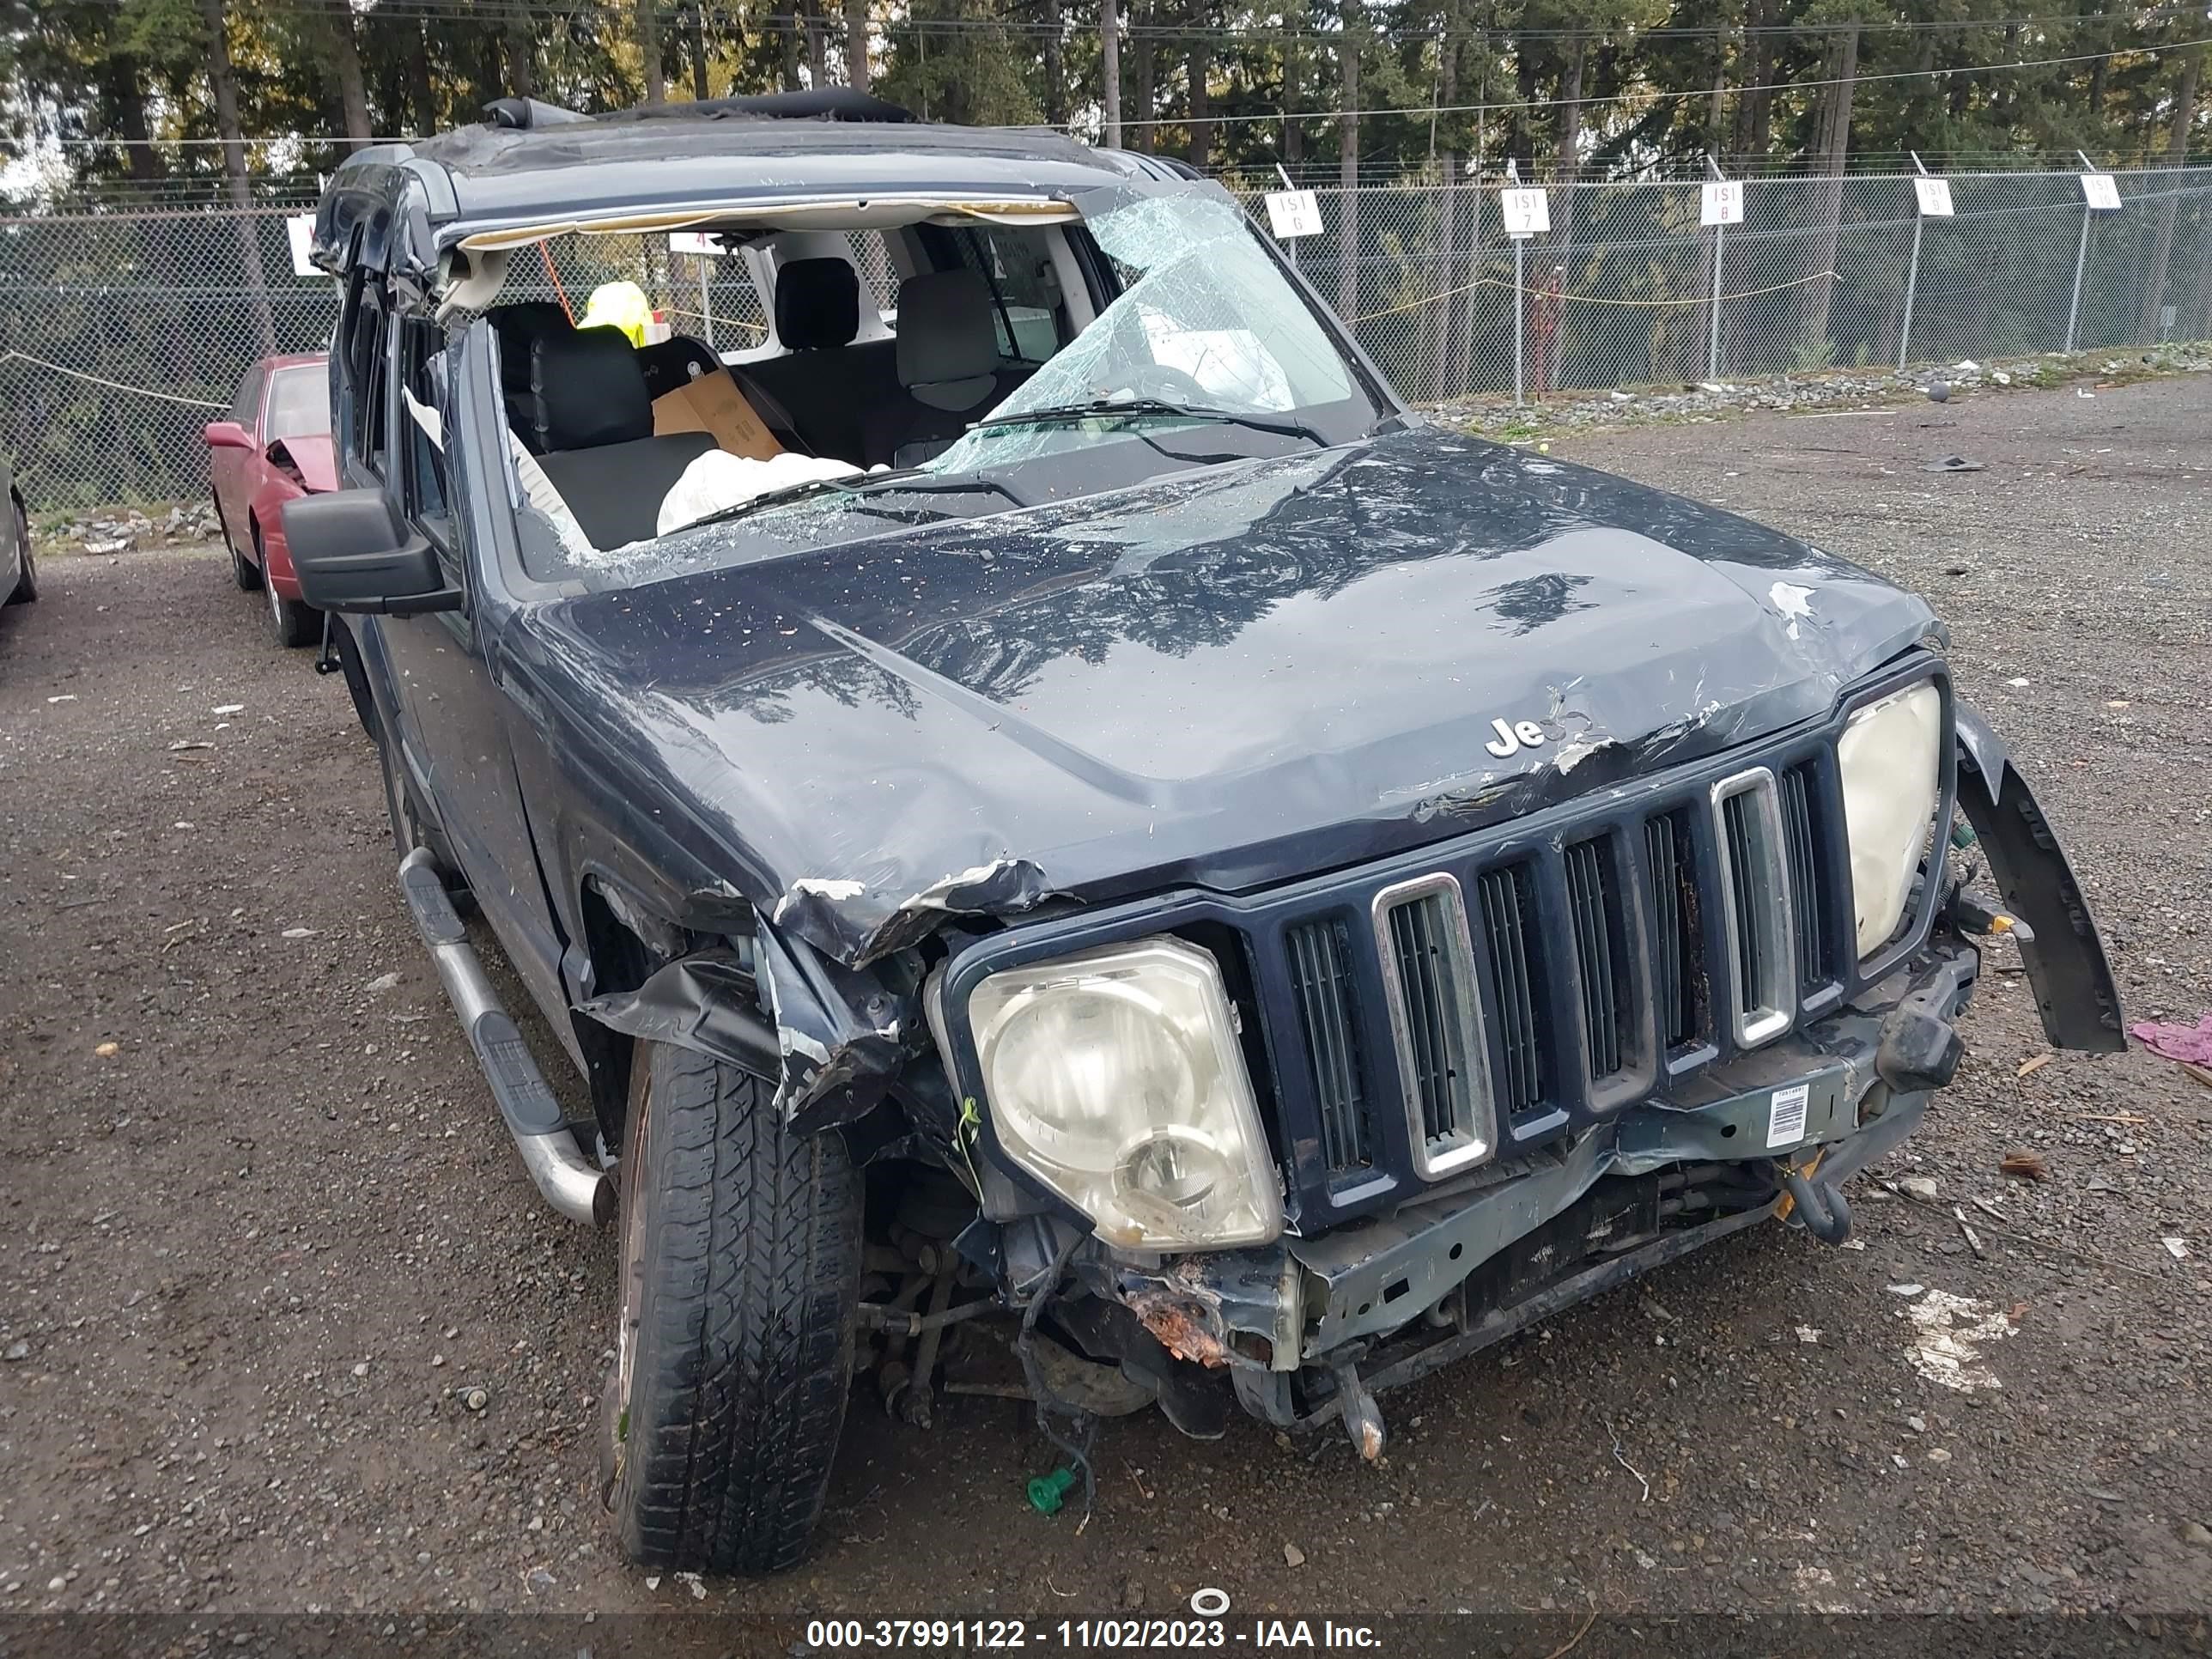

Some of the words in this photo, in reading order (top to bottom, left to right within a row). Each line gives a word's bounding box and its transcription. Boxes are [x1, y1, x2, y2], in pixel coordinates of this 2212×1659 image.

[1933, 199, 1940, 211] 9
[1721, 206, 1729, 220] 8
[1293, 216, 1303, 231] 6
[1524, 214, 1531, 228] 7
